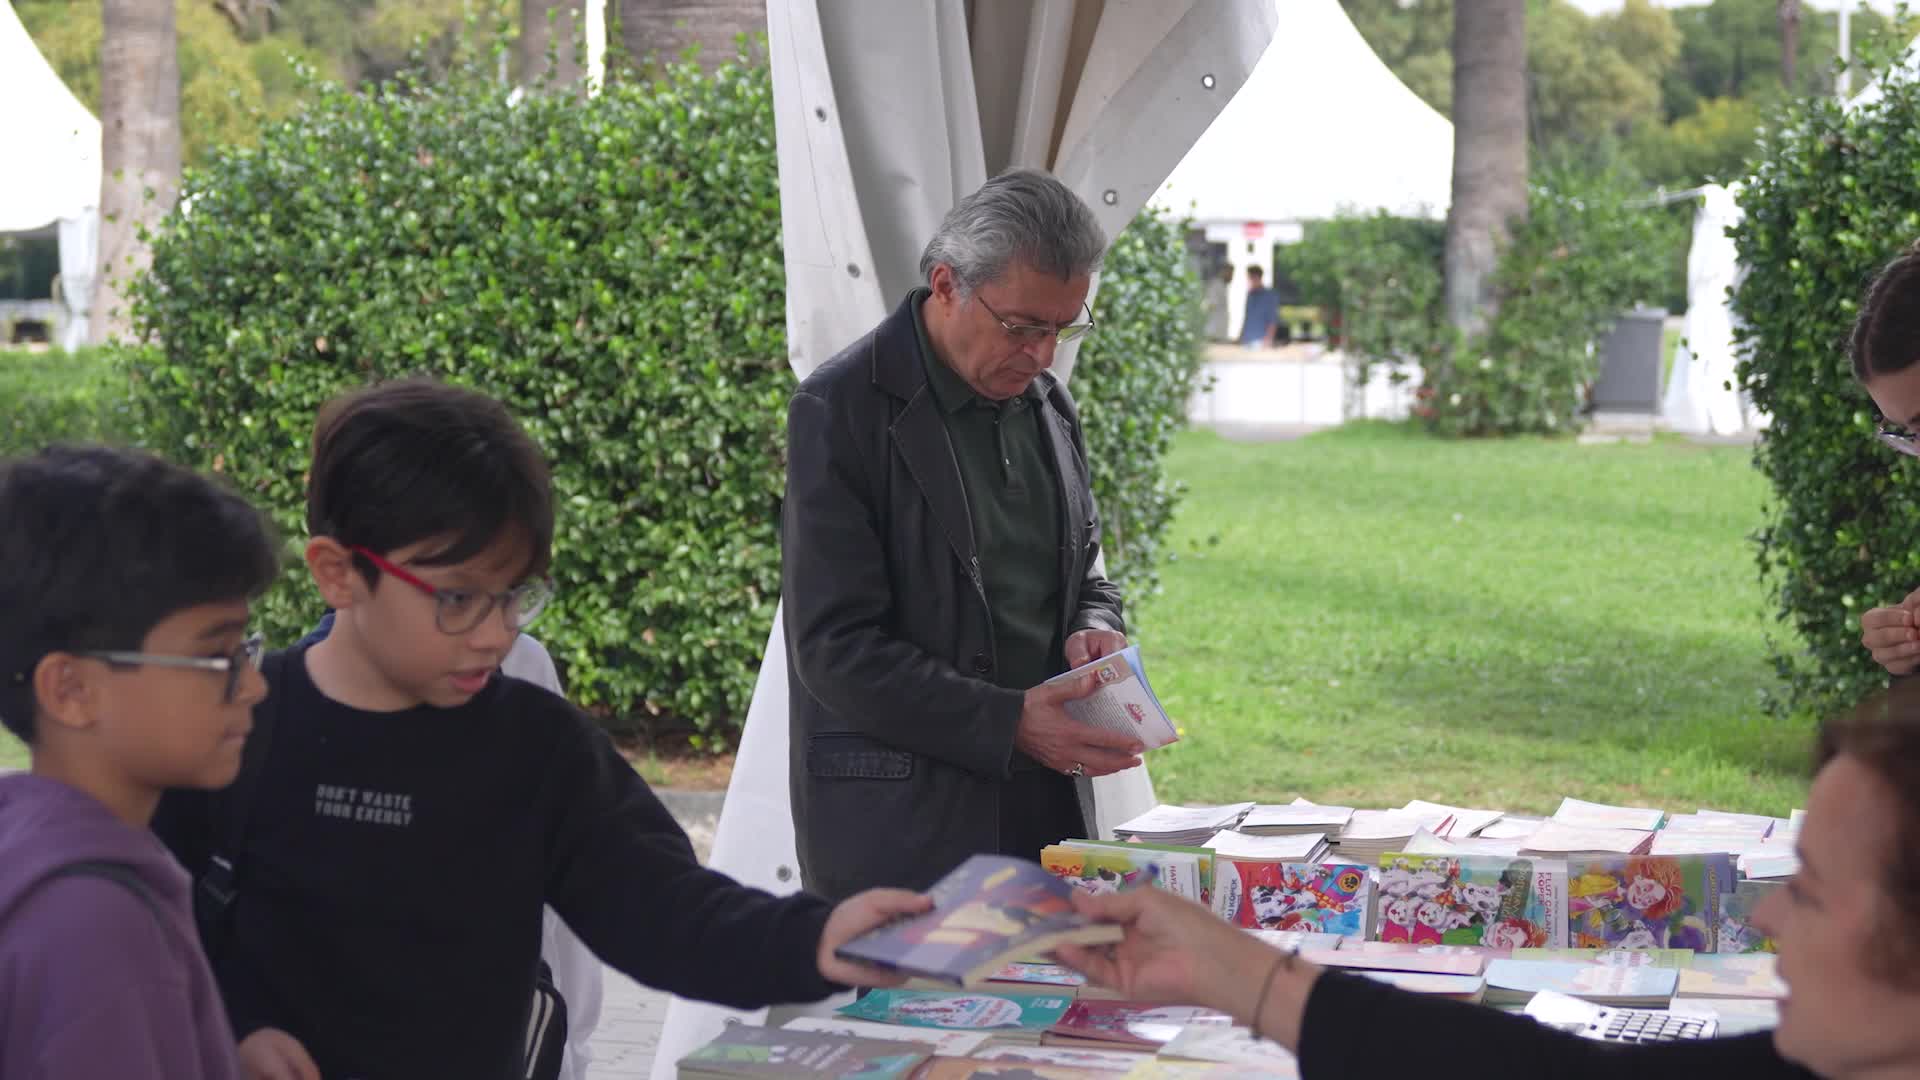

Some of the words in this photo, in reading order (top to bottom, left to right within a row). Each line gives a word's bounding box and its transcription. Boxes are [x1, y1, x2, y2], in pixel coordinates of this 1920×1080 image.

[362, 791, 411, 810] WASTE
[314, 800, 352, 818] YOUR
[356, 805, 412, 826] ENERGY
